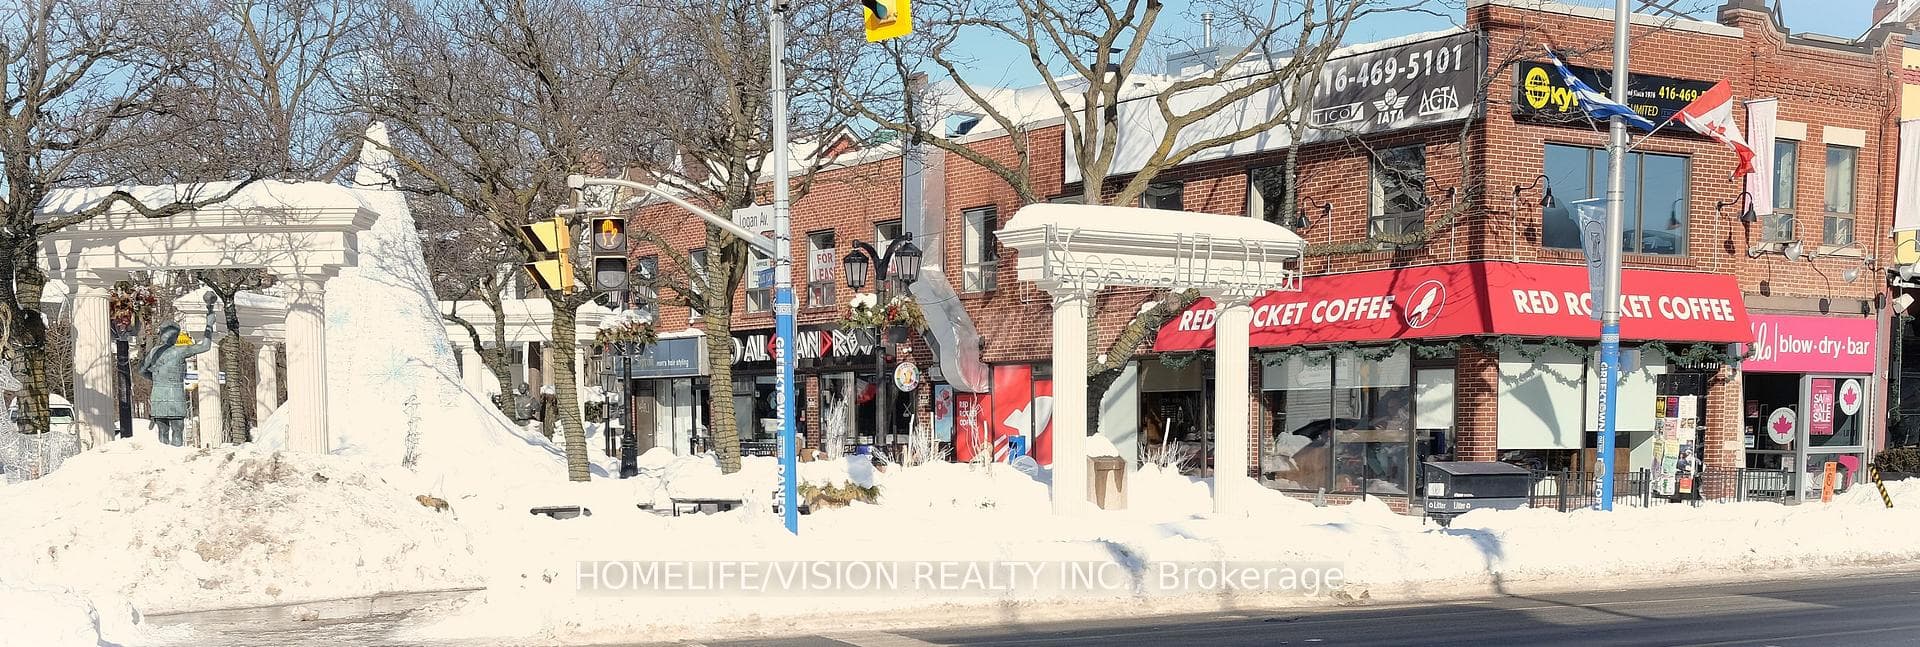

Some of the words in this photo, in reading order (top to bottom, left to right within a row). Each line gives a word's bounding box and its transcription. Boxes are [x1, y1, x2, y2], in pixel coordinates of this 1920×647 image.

[1314, 108, 1350, 125] TICO
[1377, 110, 1405, 125] IATA
[739, 214, 758, 231] Logan
[816, 252, 834, 265] FOR
[1178, 308, 1216, 331] RED
[1248, 301, 1307, 328] CKET
[1311, 295, 1396, 323] COFFEE
[1512, 289, 1559, 315] RED
[1564, 291, 1653, 318] ROKET
[1658, 295, 1735, 322] COFFEE
[775, 335, 787, 431] GREEKTOWN
[1598, 361, 1608, 432] GREEKTOWN
[1813, 412, 1831, 423] SALE
[1433, 501, 1446, 509] Litter
